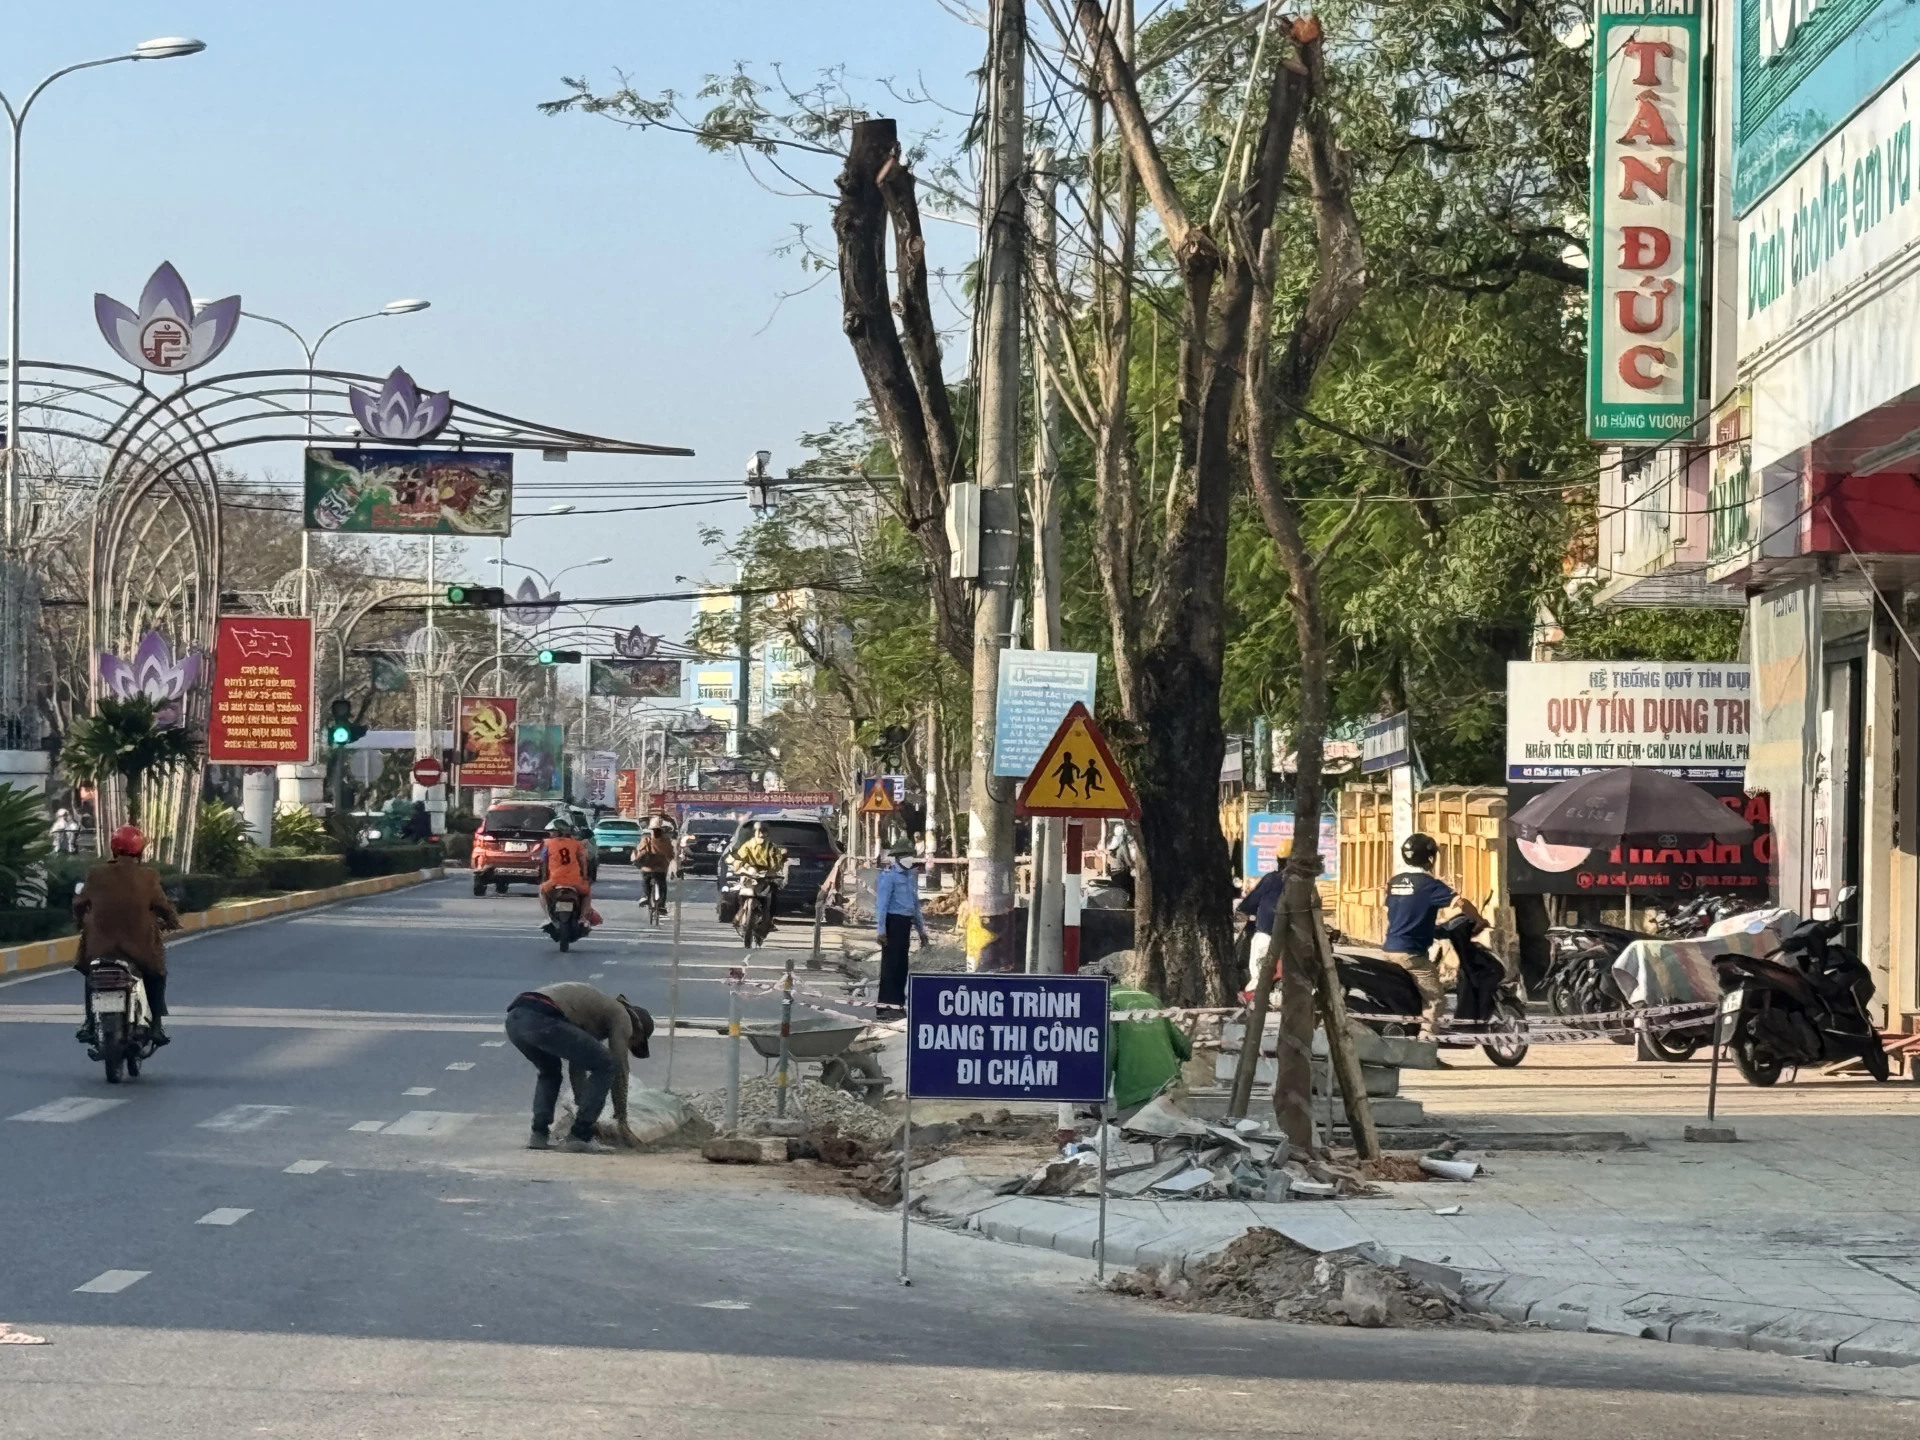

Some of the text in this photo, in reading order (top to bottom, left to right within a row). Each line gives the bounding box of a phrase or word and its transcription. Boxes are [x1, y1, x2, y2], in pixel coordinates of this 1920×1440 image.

[1616, 41, 1676, 201] TÂN
[1853, 144, 1882, 238] em
[1887, 83, 1911, 214] và
[1615, 226, 1675, 390] ĐỨC
[1594, 413, 1608, 429] 18
[1612, 666, 1661, 689] THỐNG
[1697, 668, 1722, 688] TÍN
[1596, 690, 1635, 734] TÍN
[1643, 698, 1709, 741] DỤNG
[1646, 743, 1666, 760] CHO
[1669, 743, 1687, 760] VAY
[1737, 743, 1750, 760] PH
[938, 985, 1081, 1018] CÔNG TRÌNH
[918, 1020, 1099, 1052] ĐANG THI CÔNG
[957, 1054, 1059, 1092] ĐI CHẬM
